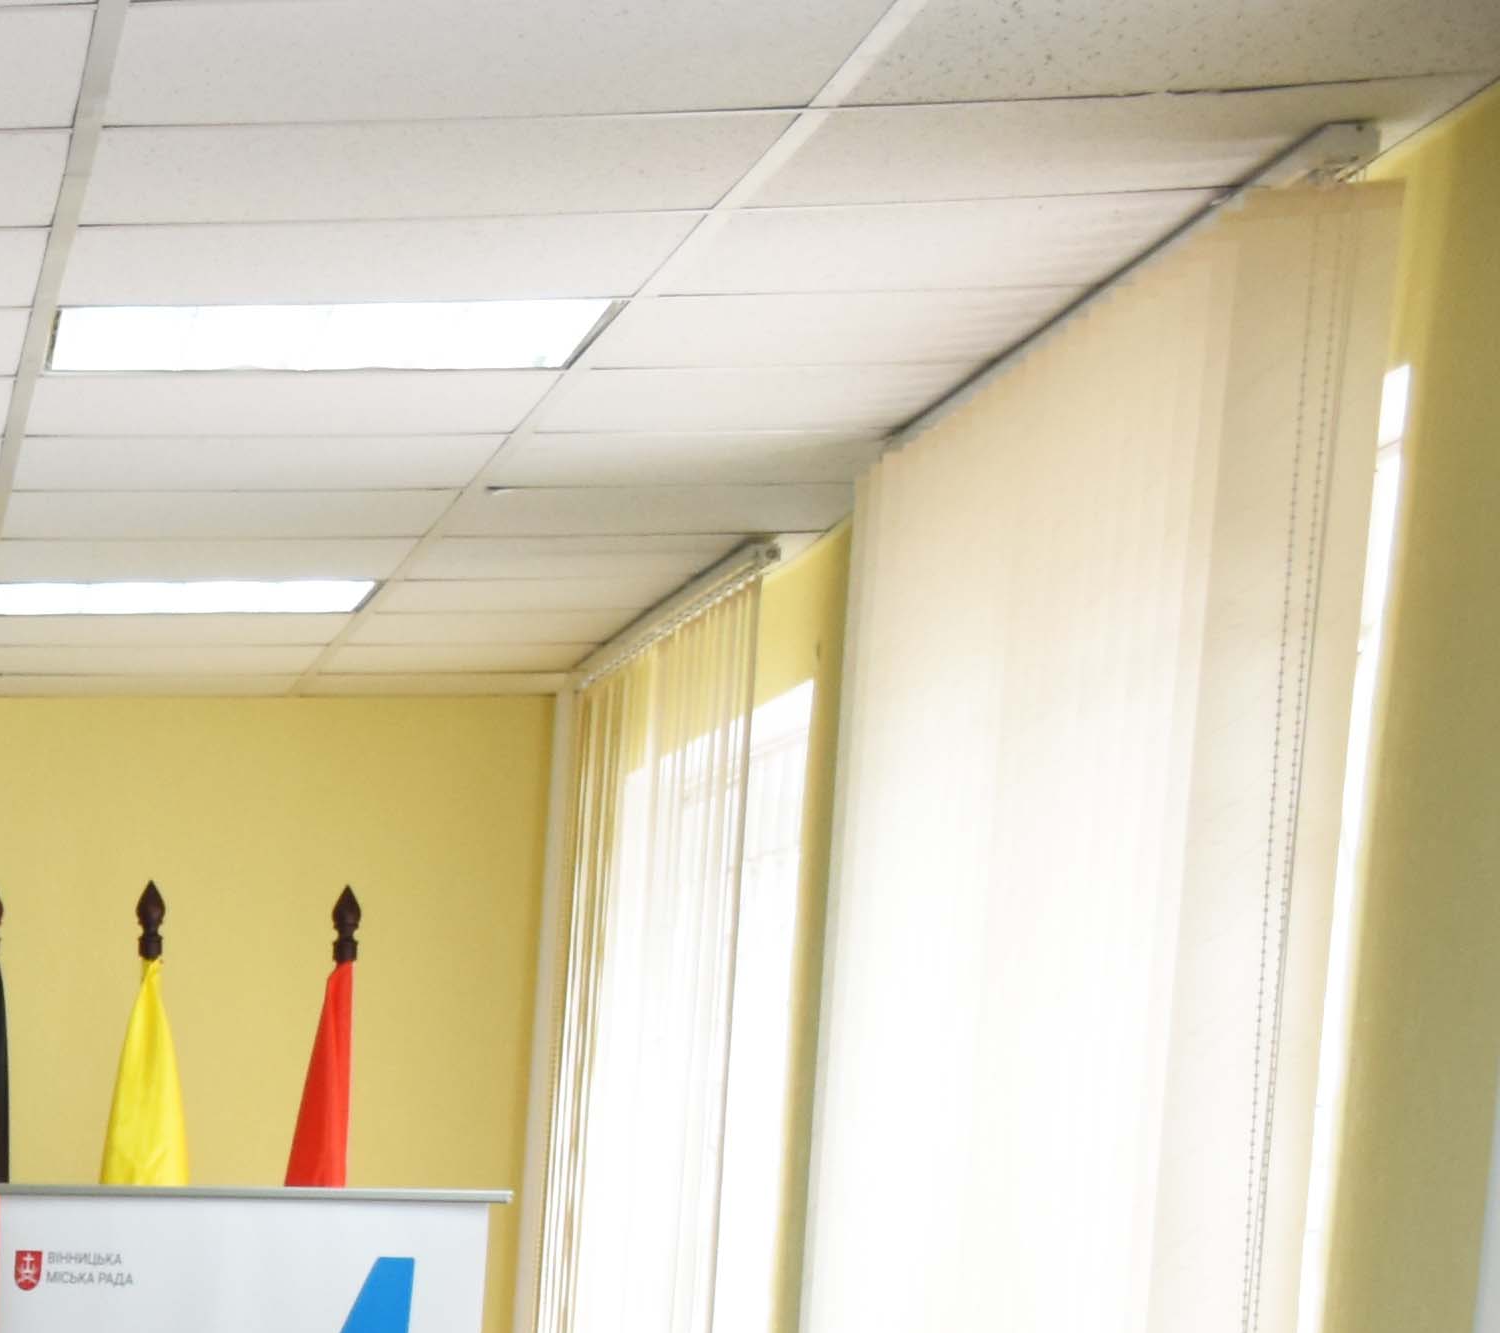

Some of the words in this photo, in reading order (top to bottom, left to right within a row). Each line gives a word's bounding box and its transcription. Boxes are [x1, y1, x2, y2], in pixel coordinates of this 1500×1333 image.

[47, 1251, 122, 1266] ВІННИЦЬКА
[46, 1271, 94, 1284] МІСЬКА
[98, 1272, 133, 1286] РАДА
